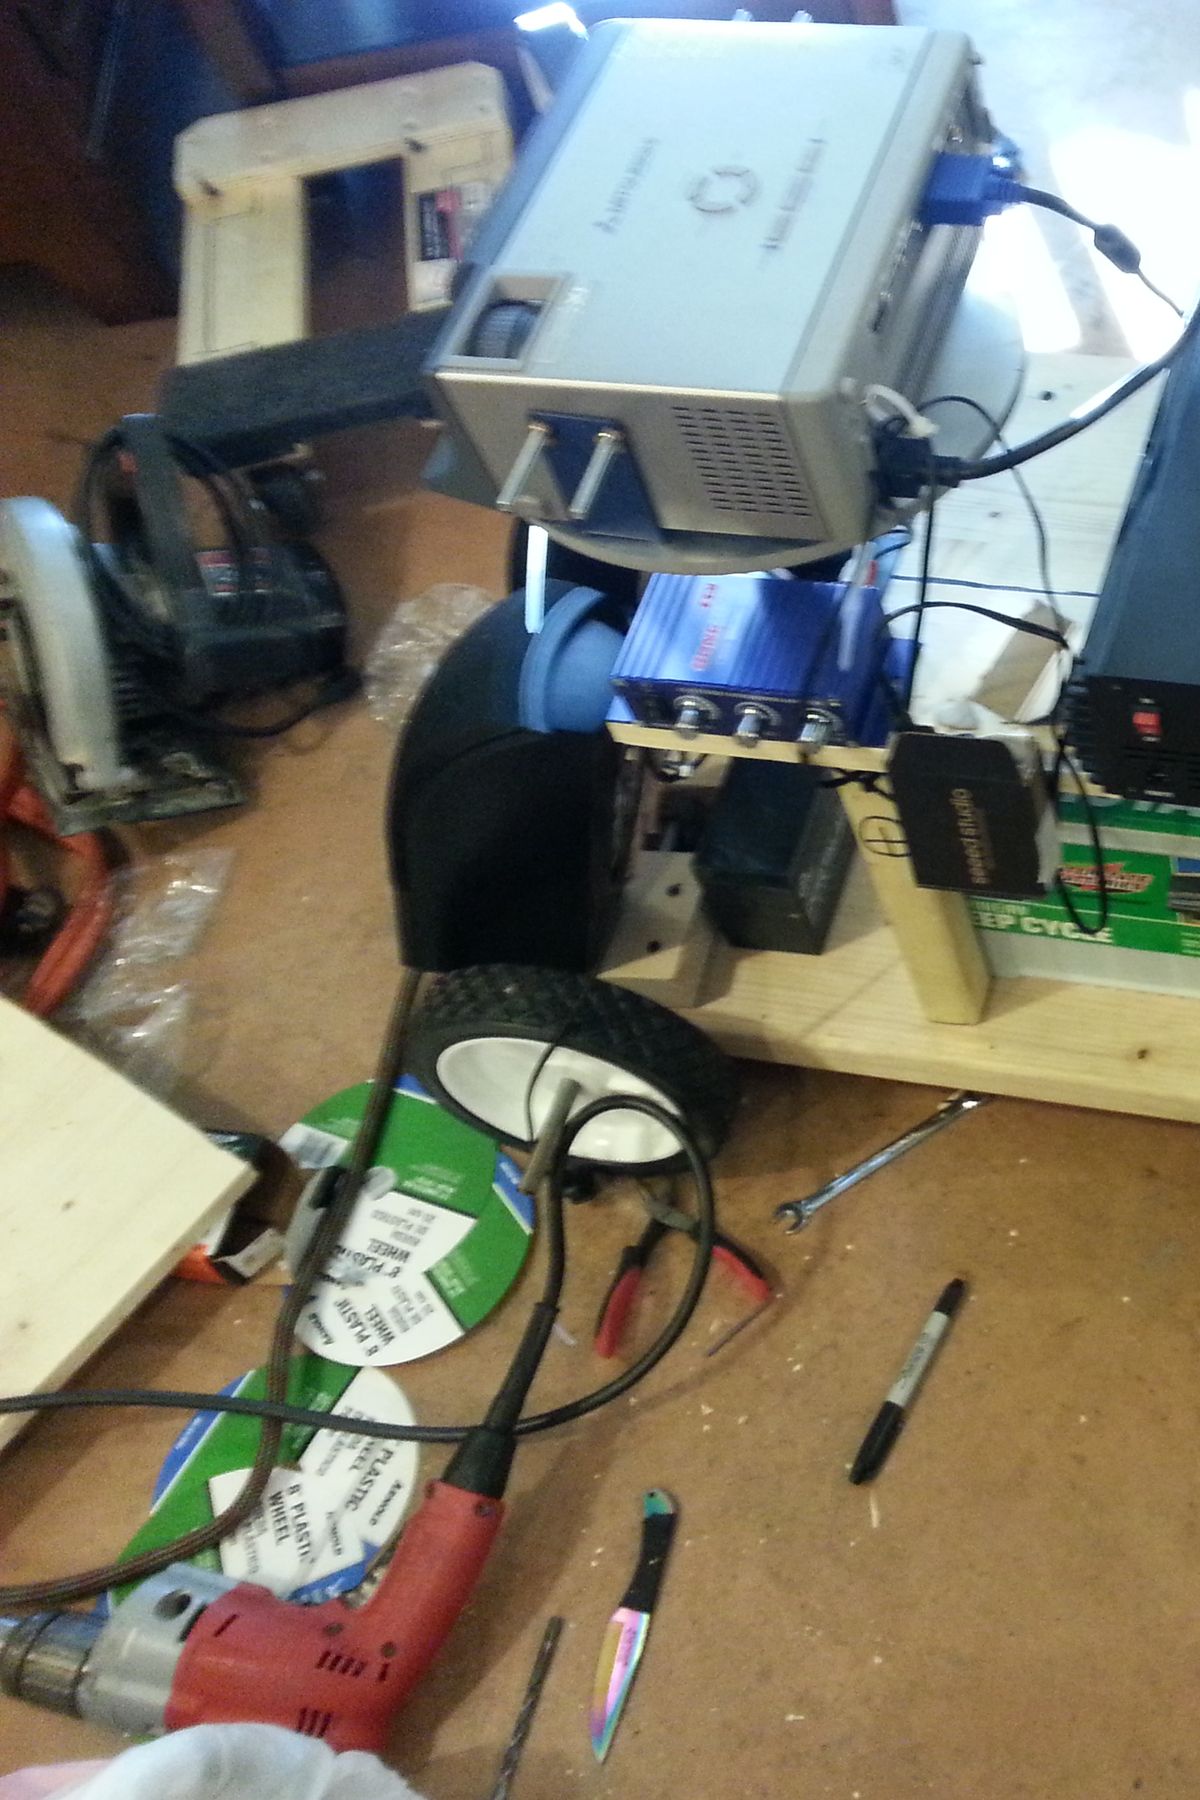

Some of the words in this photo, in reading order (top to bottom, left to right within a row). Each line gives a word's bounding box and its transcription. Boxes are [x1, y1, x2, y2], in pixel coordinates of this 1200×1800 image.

[949, 788, 976, 835] studio
[366, 1237, 411, 1264] WHEEL
[333, 1299, 371, 1344] PLASTIC
[364, 1303, 396, 1347] WHEEL
[344, 1446, 394, 1512] PLASTIC
[268, 1490, 291, 1547] WHEEL
